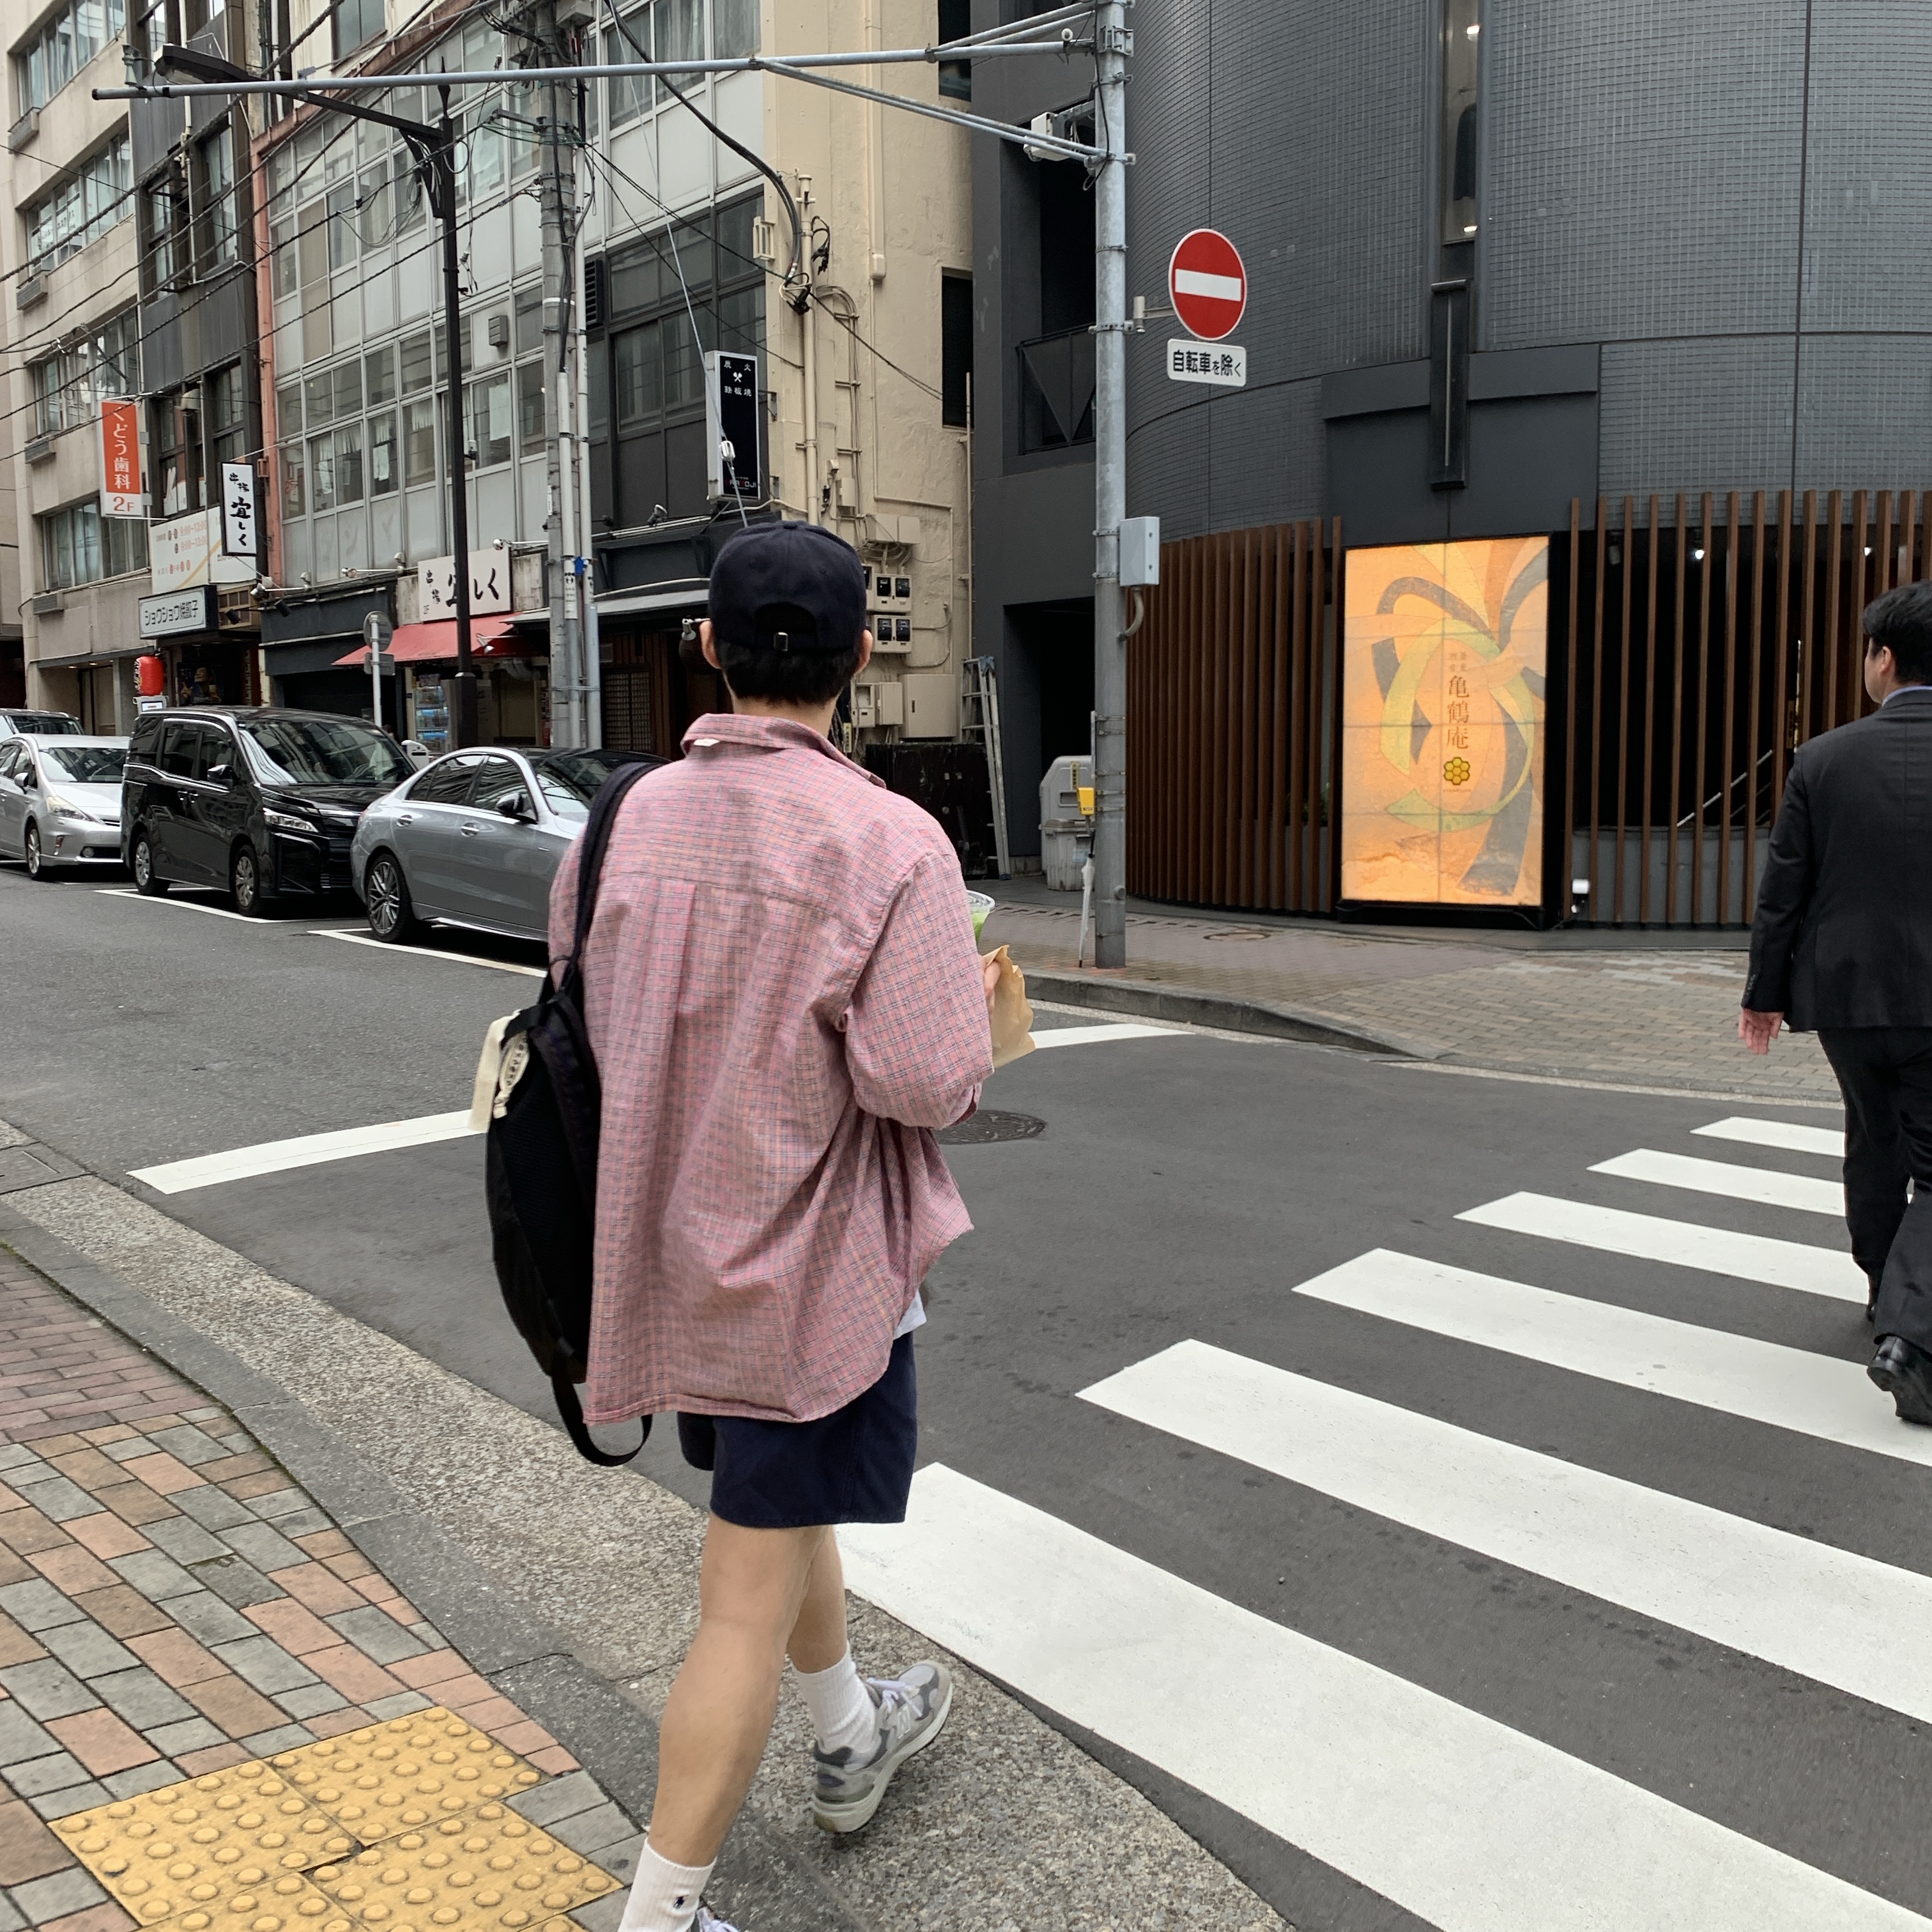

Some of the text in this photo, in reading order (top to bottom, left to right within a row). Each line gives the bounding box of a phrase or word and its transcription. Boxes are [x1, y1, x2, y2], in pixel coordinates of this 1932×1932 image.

[1173, 349, 1241, 377] 自転車を除く
[113, 406, 130, 489] くどう歯科
[113, 496, 134, 512] 2F
[1446, 675, 1470, 750] 亀鶴庵
